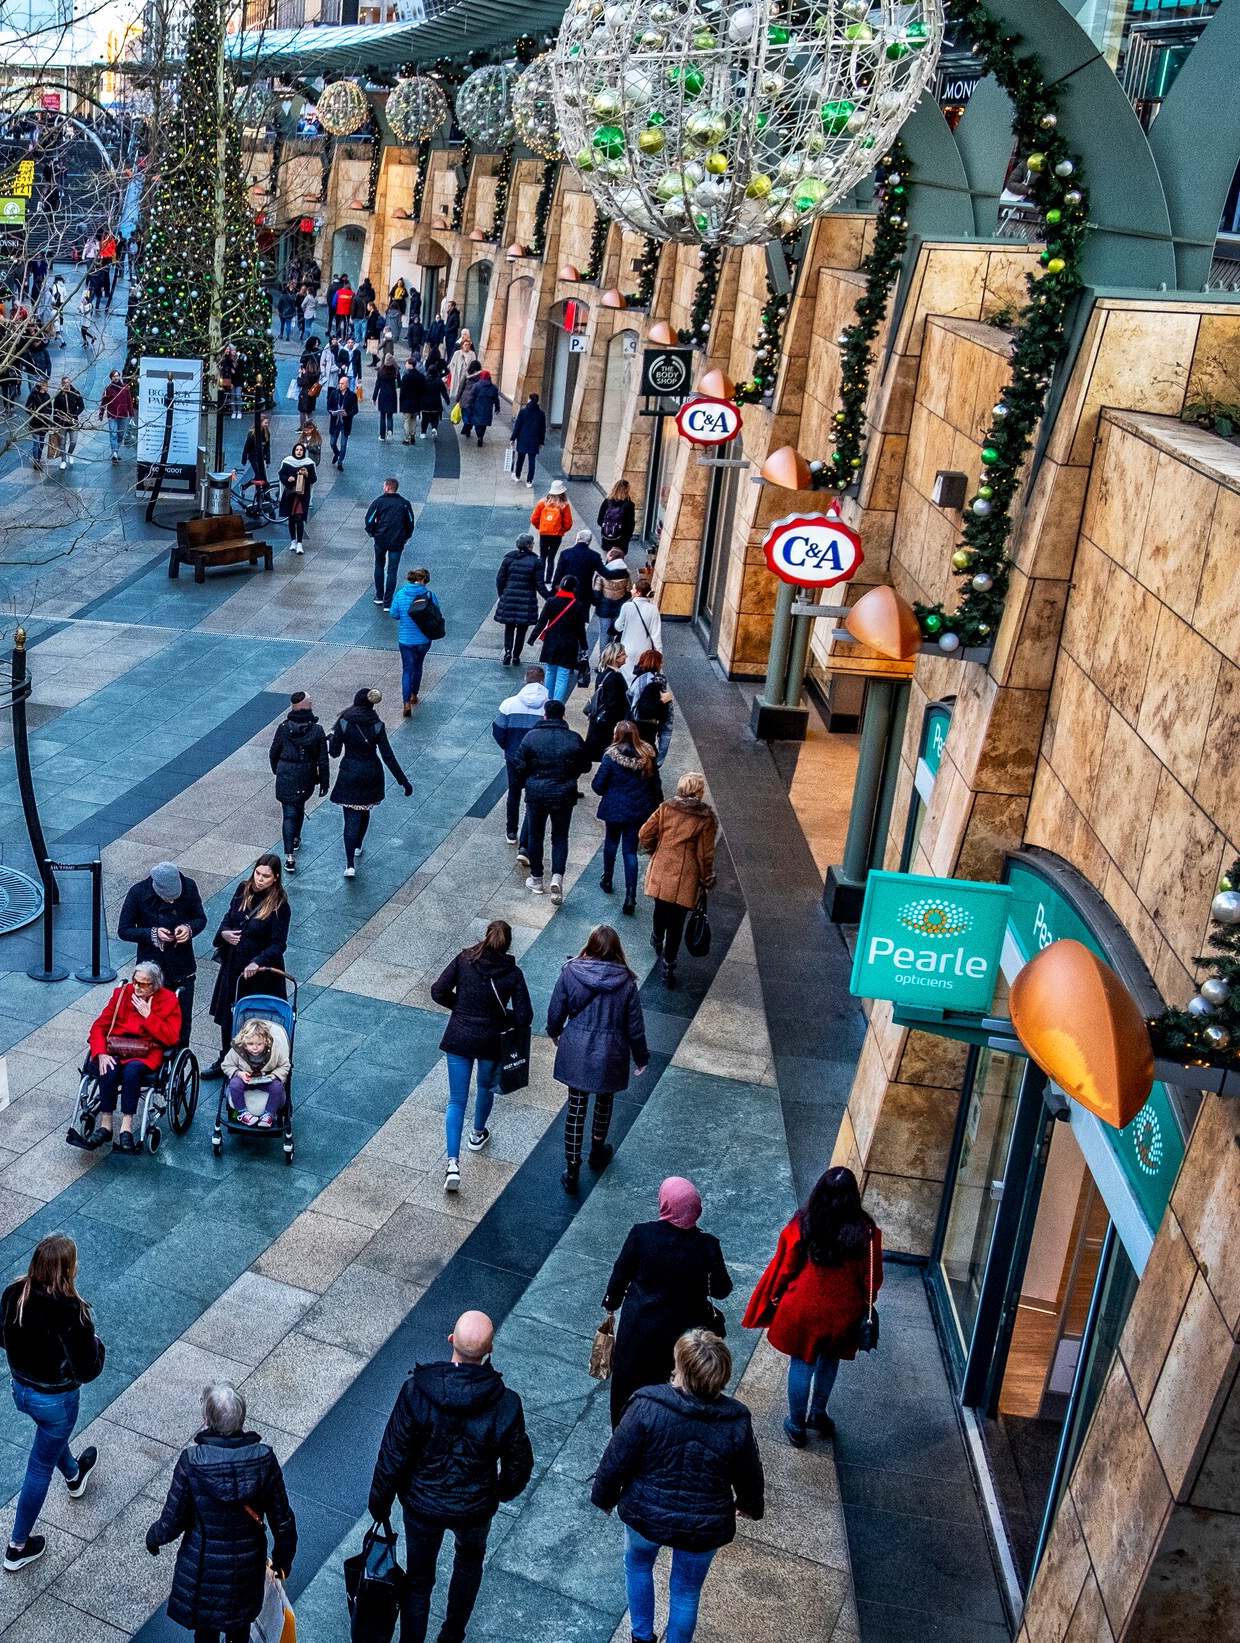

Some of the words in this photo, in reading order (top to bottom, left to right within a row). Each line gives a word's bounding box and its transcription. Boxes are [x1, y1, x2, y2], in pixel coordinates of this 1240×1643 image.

[688, 410, 730, 434] C&A
[152, 466, 183, 474] KOGOOT
[782, 535, 845, 572] C&A
[868, 937, 988, 979] Pearle
[895, 974, 953, 990] opticiens
